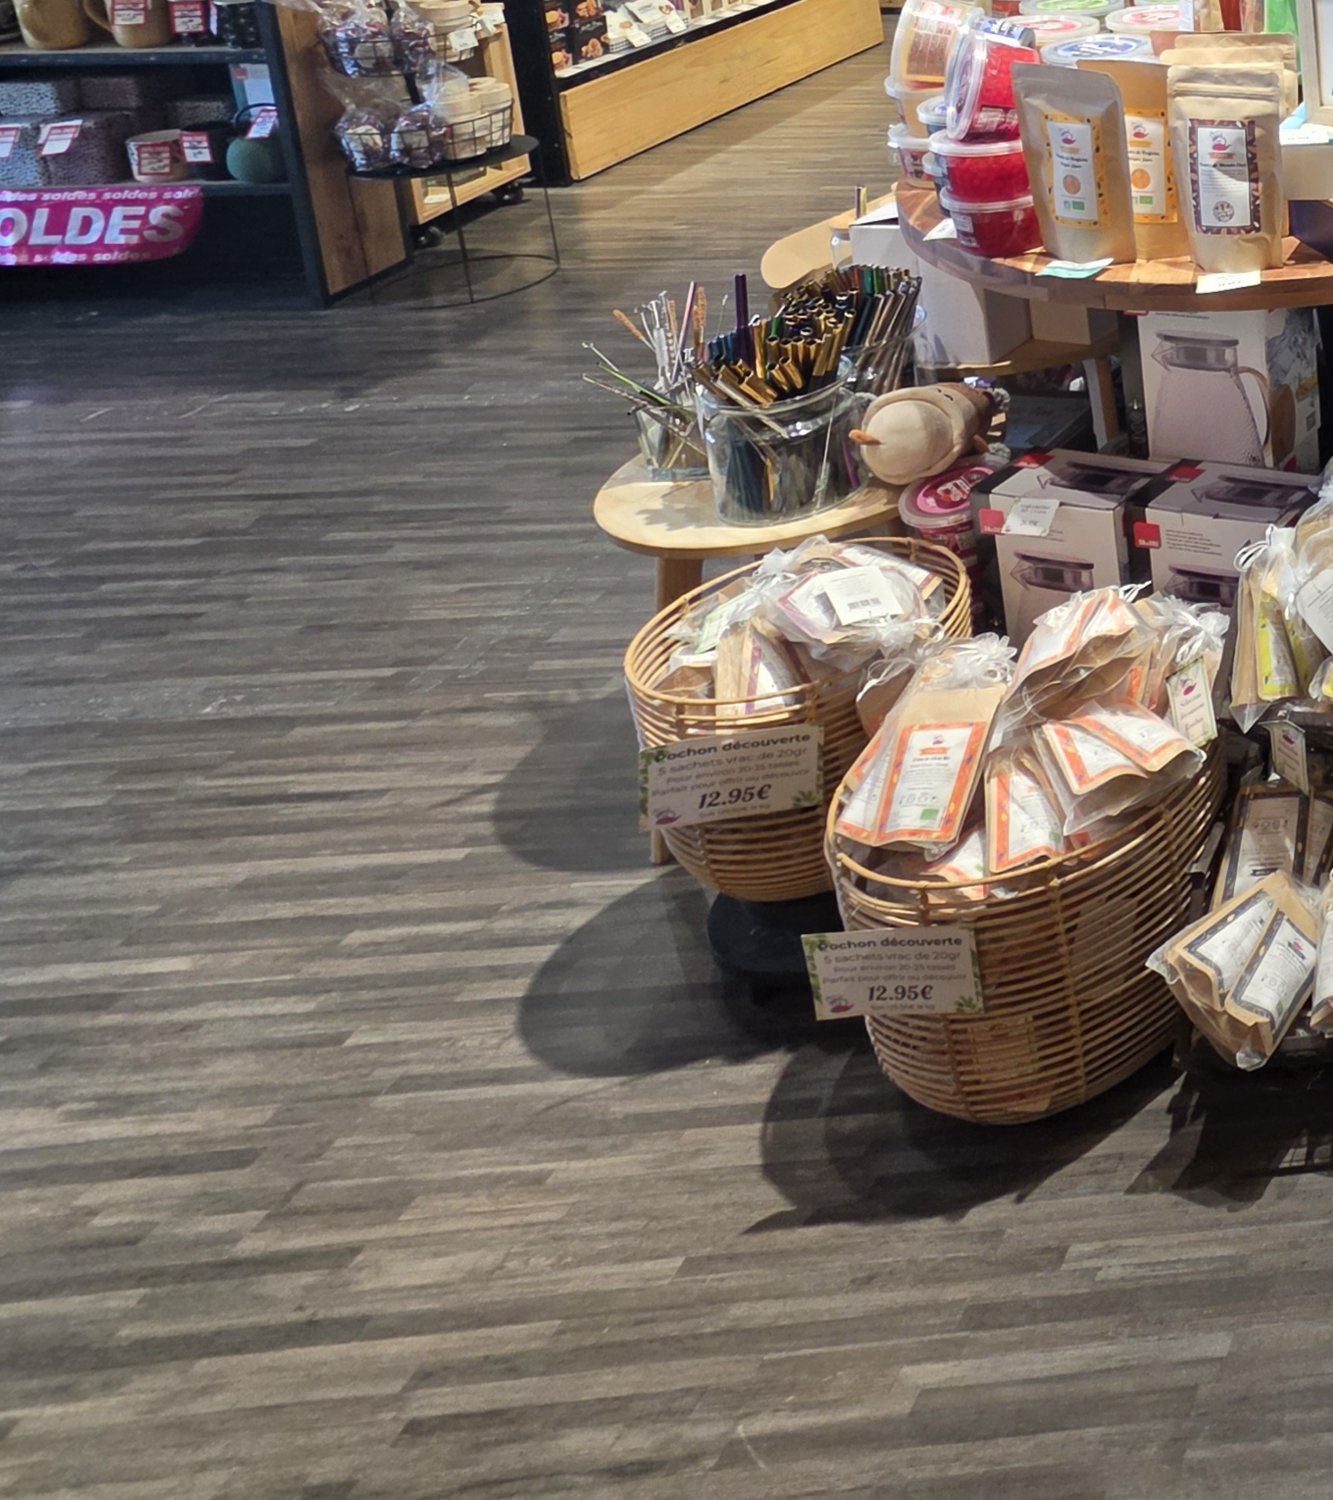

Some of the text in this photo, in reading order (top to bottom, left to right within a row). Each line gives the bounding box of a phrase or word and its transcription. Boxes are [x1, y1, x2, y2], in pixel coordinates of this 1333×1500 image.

[41, 189, 158, 201] soldes soldes
[0, 205, 186, 247] OLDES
[721, 733, 811, 751] découverte
[669, 757, 723, 773] sachets
[725, 754, 754, 764] vrac
[758, 749, 774, 760] de
[778, 747, 808, 759] 20gr
[698, 784, 772, 809] 12.95€
[818, 937, 963, 951] Pochon découverte
[835, 952, 884, 963] sachets
[885, 952, 911, 960] vrac
[914, 951, 930, 960] de
[933, 951, 961, 961] 20gr
[868, 985, 934, 1001] 12.95€
